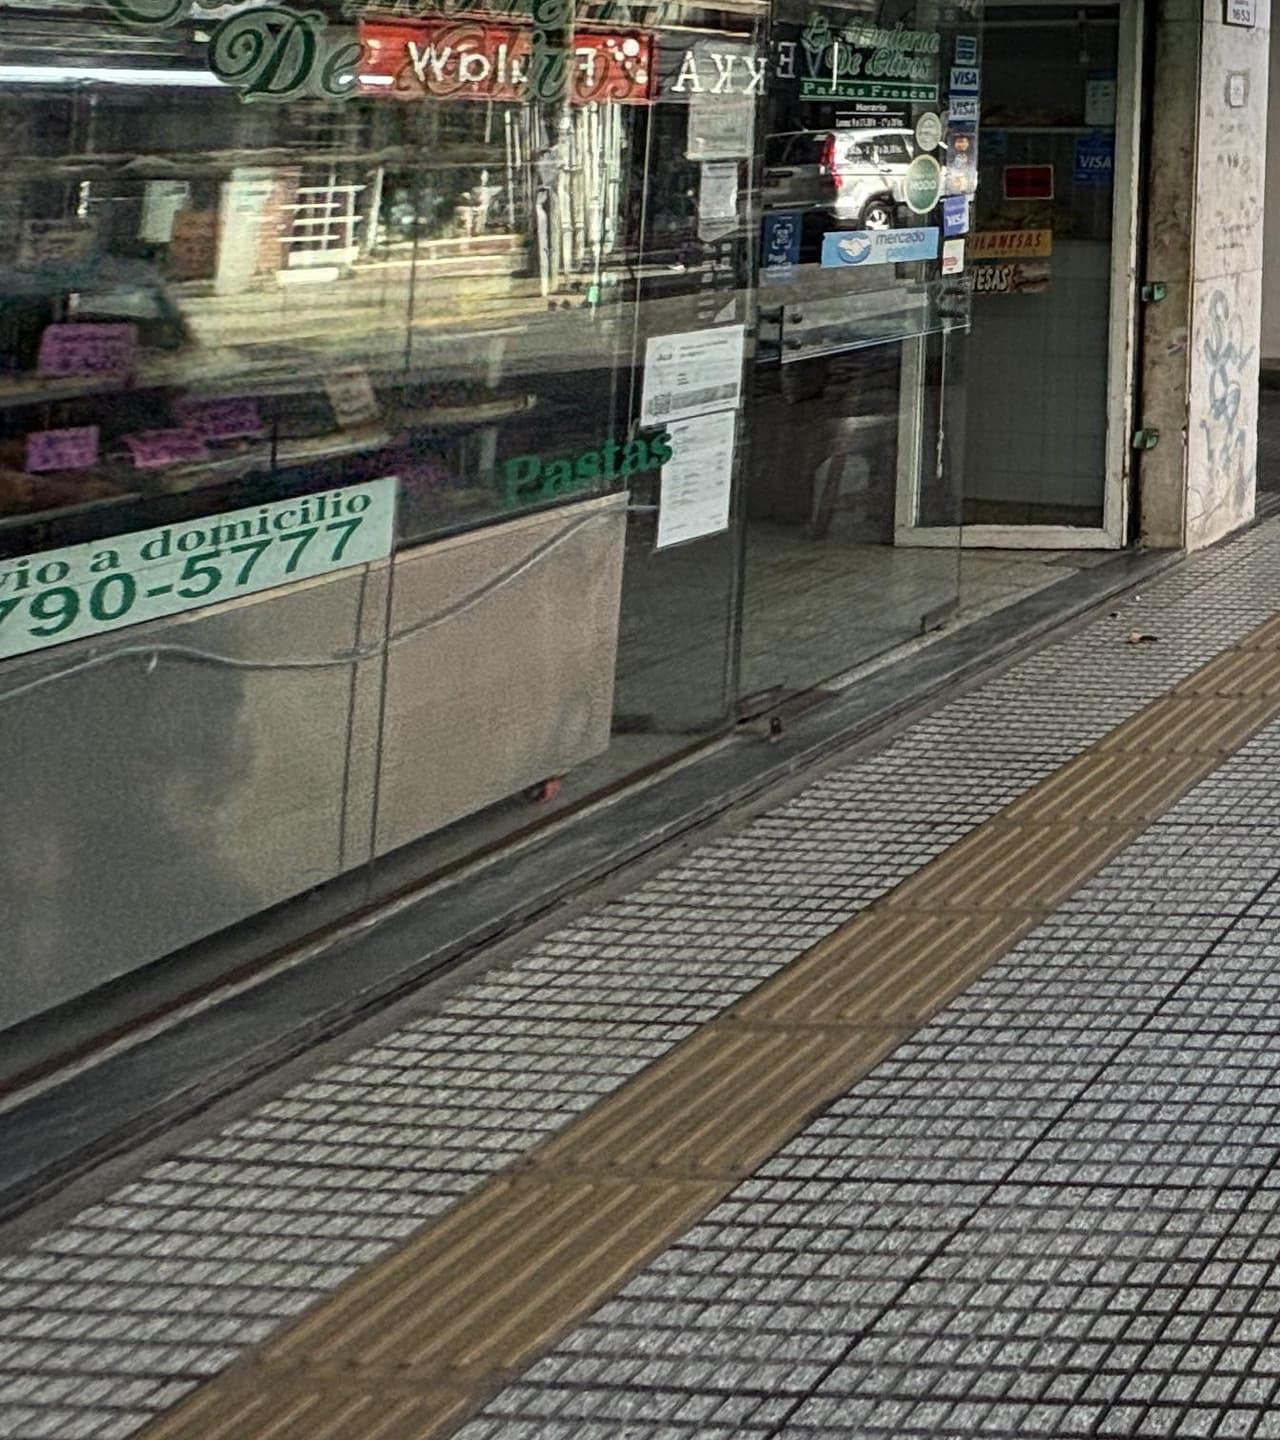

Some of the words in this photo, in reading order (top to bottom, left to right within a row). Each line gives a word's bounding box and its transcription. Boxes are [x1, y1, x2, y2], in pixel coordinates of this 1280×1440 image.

[208, 6, 368, 103] De
[953, 71, 978, 86] VISA
[803, 81, 864, 97] Pastas
[871, 85, 936, 100] Frescas
[1079, 155, 1112, 169] VISA
[876, 231, 926, 246] mercado
[972, 231, 1042, 250] ILANESAS
[504, 432, 673, 508] Pastas
[90, 550, 121, 573] a
[139, 490, 372, 563] domicilio
